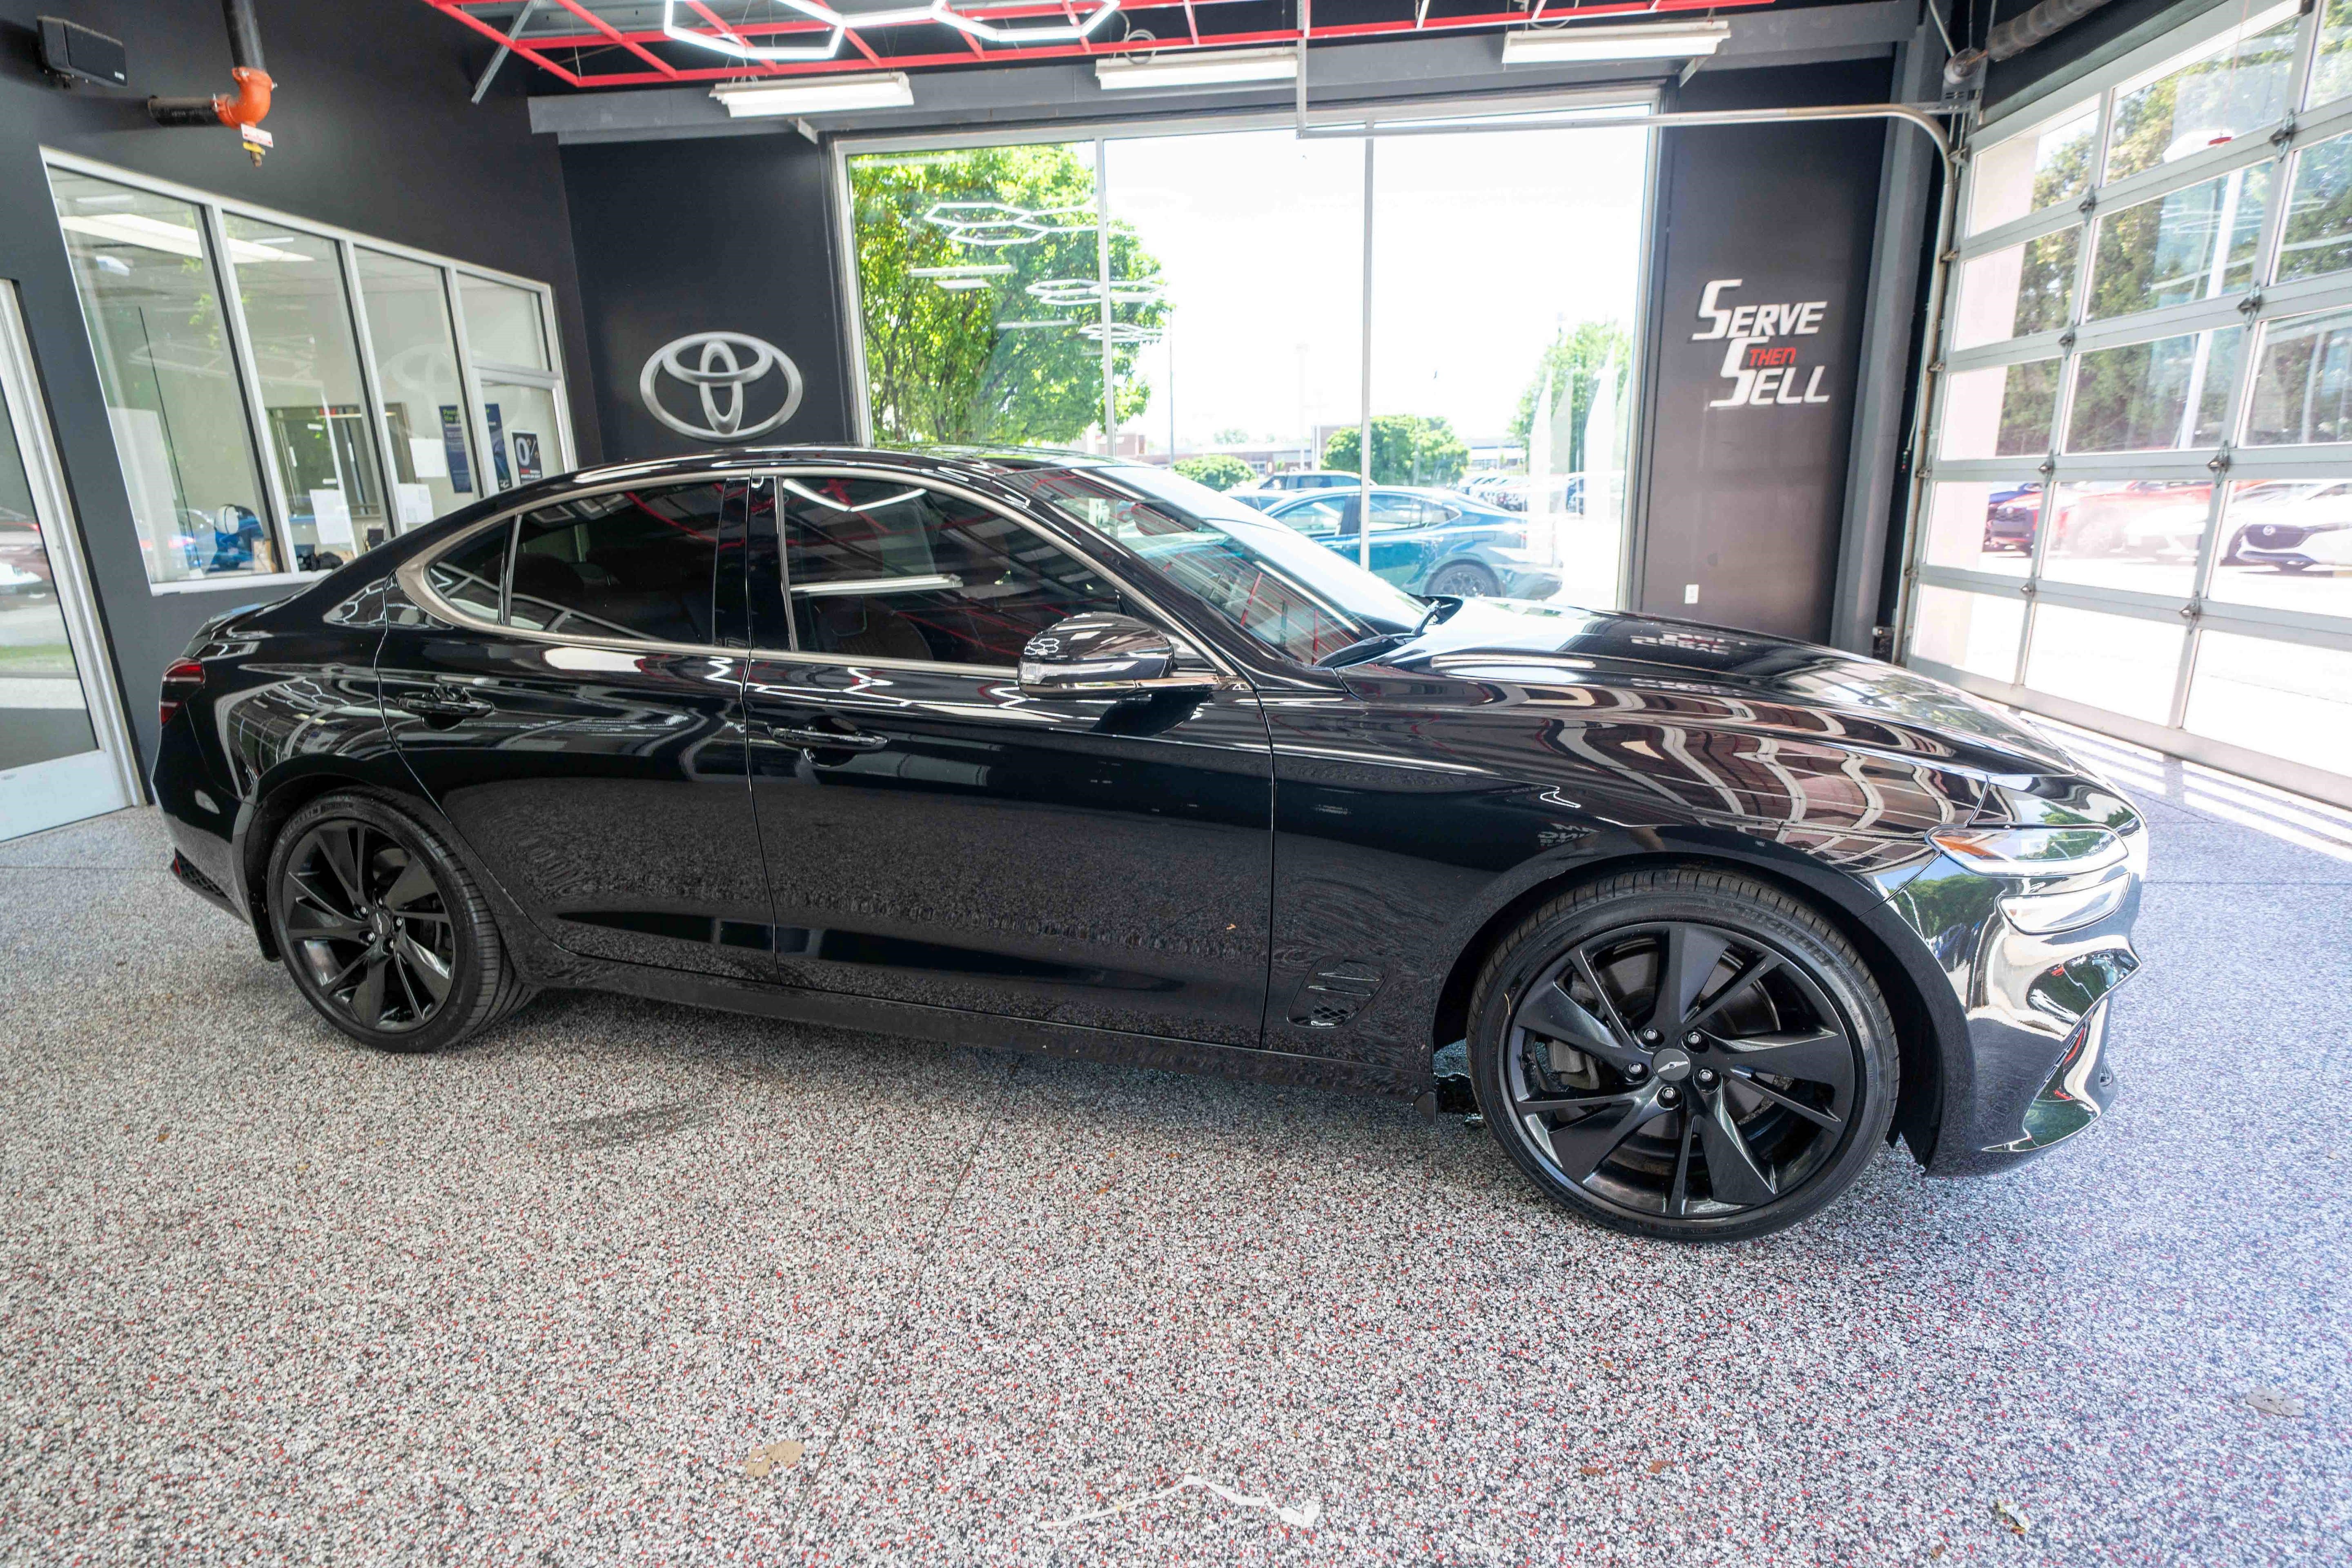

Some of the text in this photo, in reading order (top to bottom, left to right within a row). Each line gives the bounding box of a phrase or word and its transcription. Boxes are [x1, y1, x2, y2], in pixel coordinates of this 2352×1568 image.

[1692, 278, 1828, 340] SERVE
[1709, 336, 1830, 407] SELL
[515, 437, 539, 466] 0%
